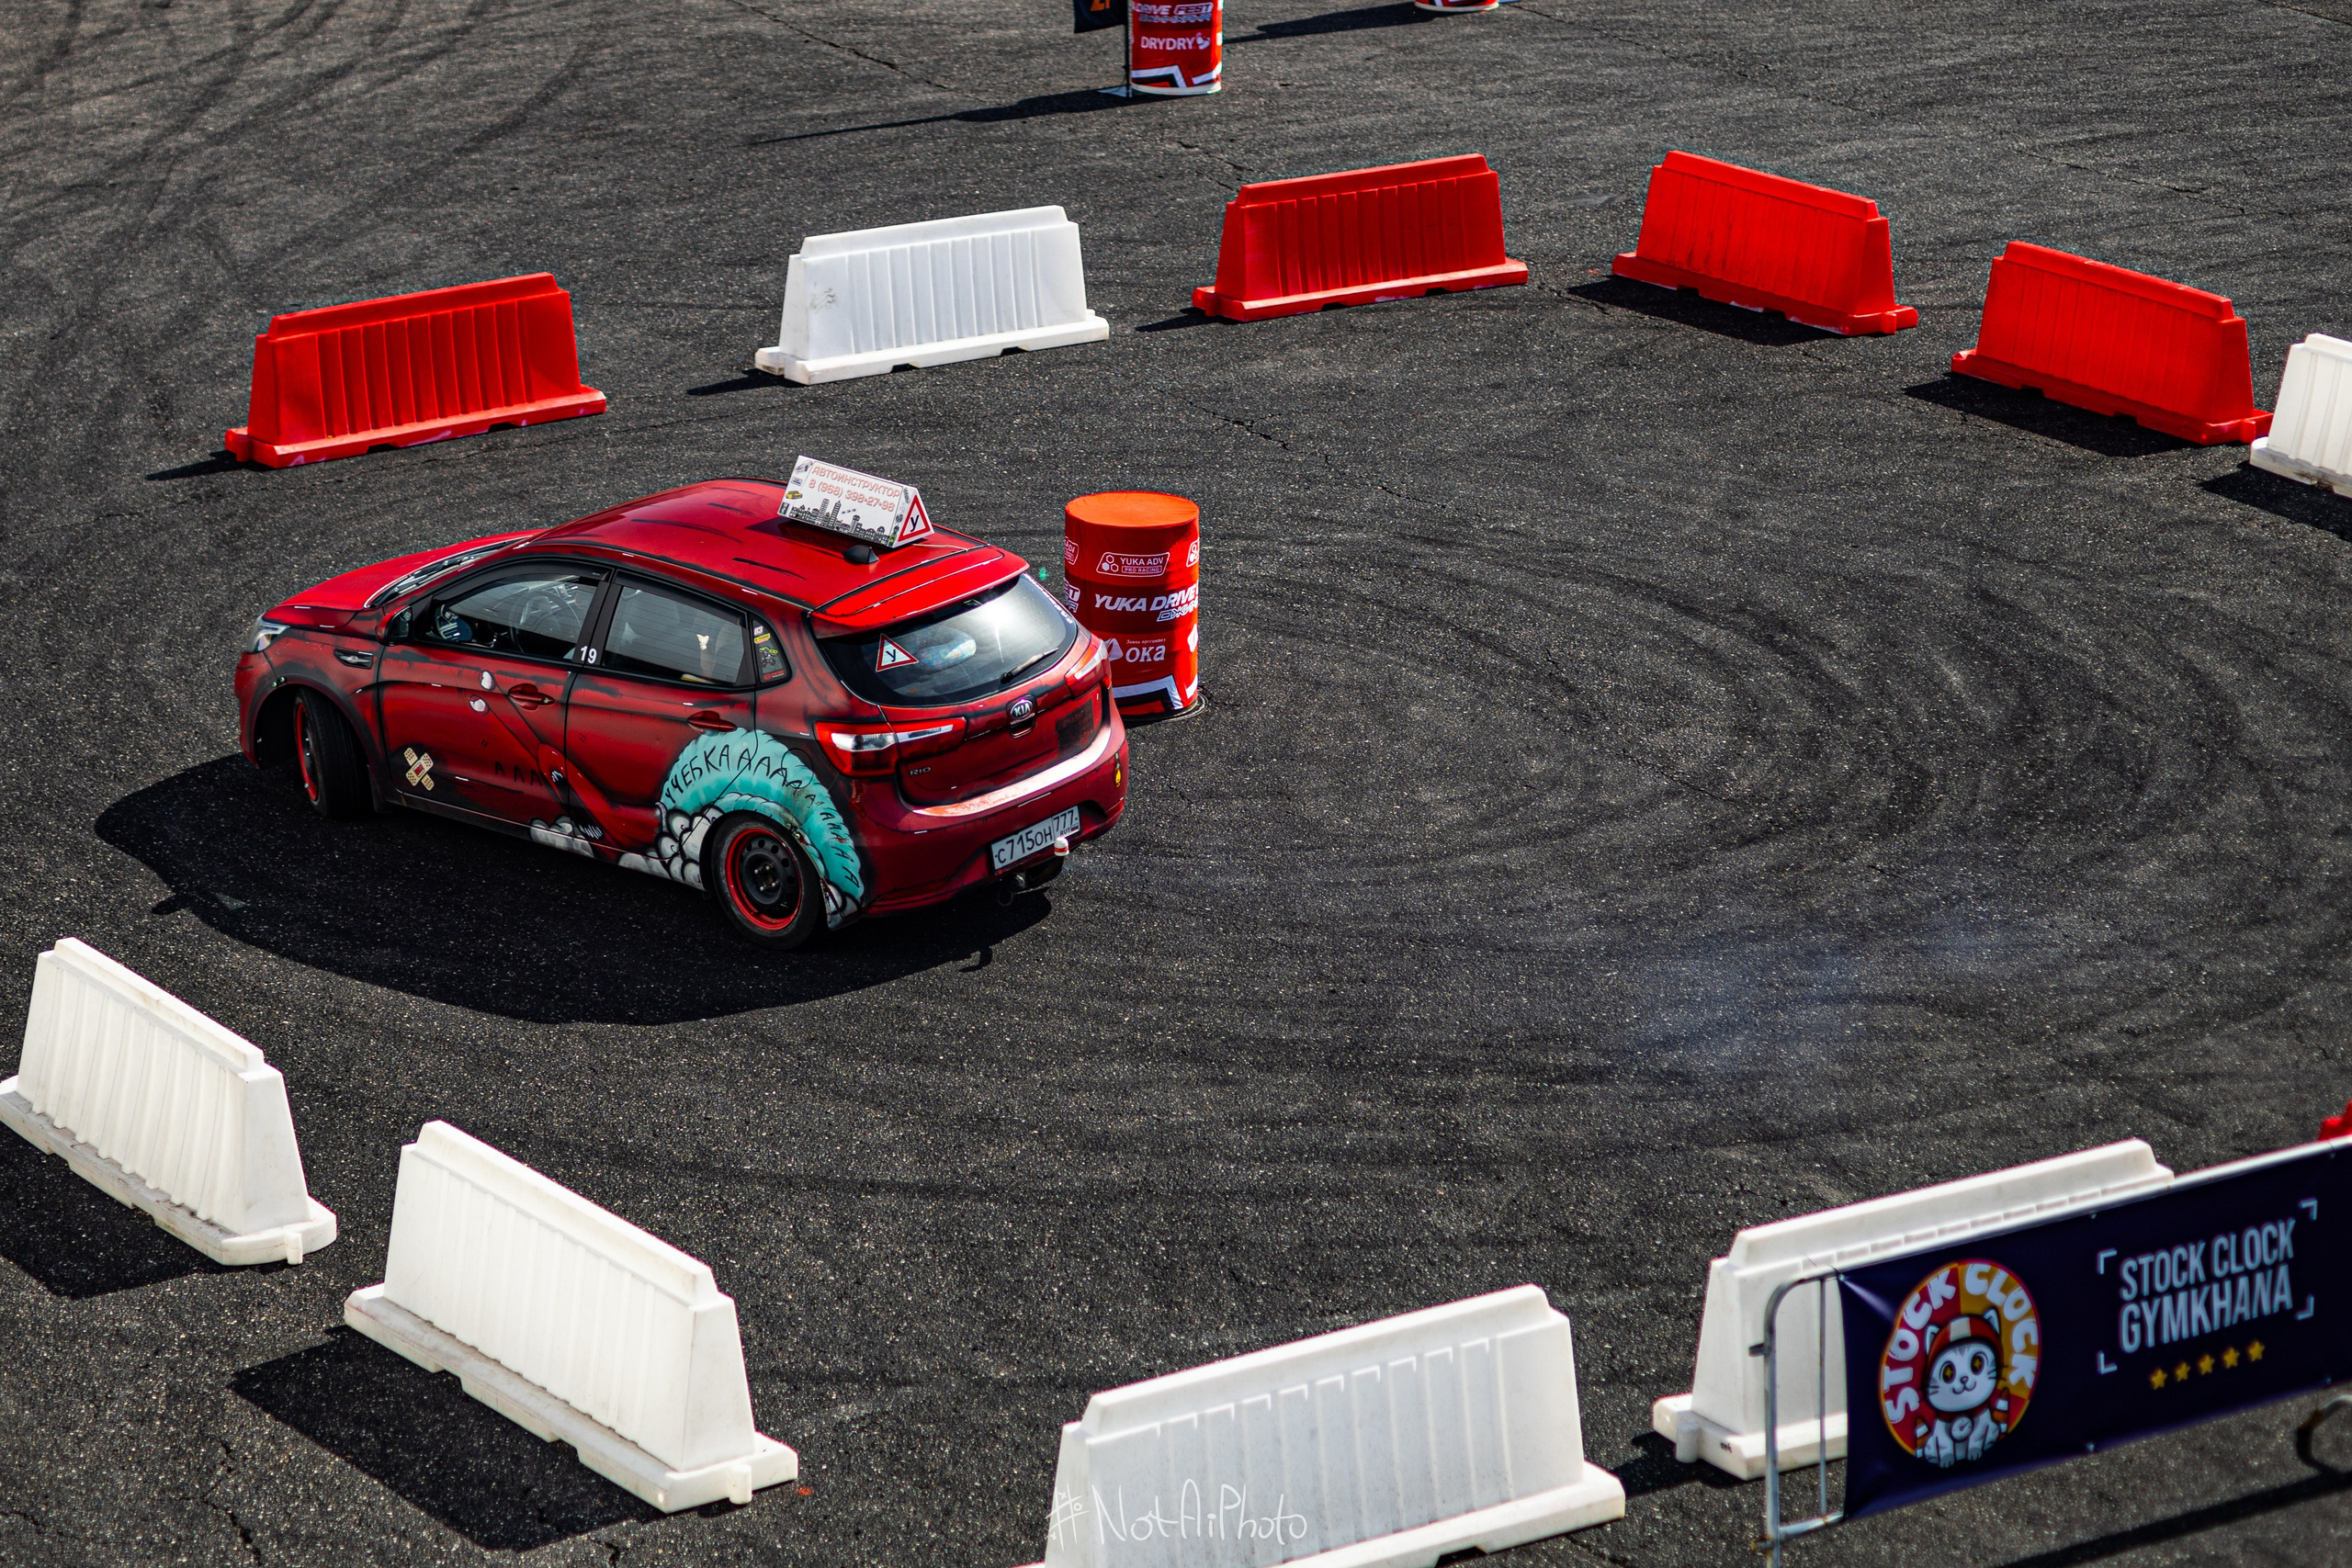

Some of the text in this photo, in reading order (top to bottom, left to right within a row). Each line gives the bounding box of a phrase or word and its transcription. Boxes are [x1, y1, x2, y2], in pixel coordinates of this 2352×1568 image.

[1140, 36, 1195, 51] DRYDRY
[808, 479, 817, 489] 8
[812, 466, 900, 498] АВТОИНСТРУКТОР
[1120, 557, 1164, 566] YUKA ADV
[1095, 593, 1147, 612] YUKA
[581, 645, 597, 664] 19
[1013, 702, 1031, 717] KIA
[910, 766, 931, 776] RIO
[1053, 809, 1074, 832] 777
[1059, 827, 1071, 836] RUS
[2120, 1217, 2296, 1302] STOCK CLOCK
[2120, 1264, 2293, 1354] GYMKHANA
[1883, 1262, 2040, 1424] STOCK CLOCK
